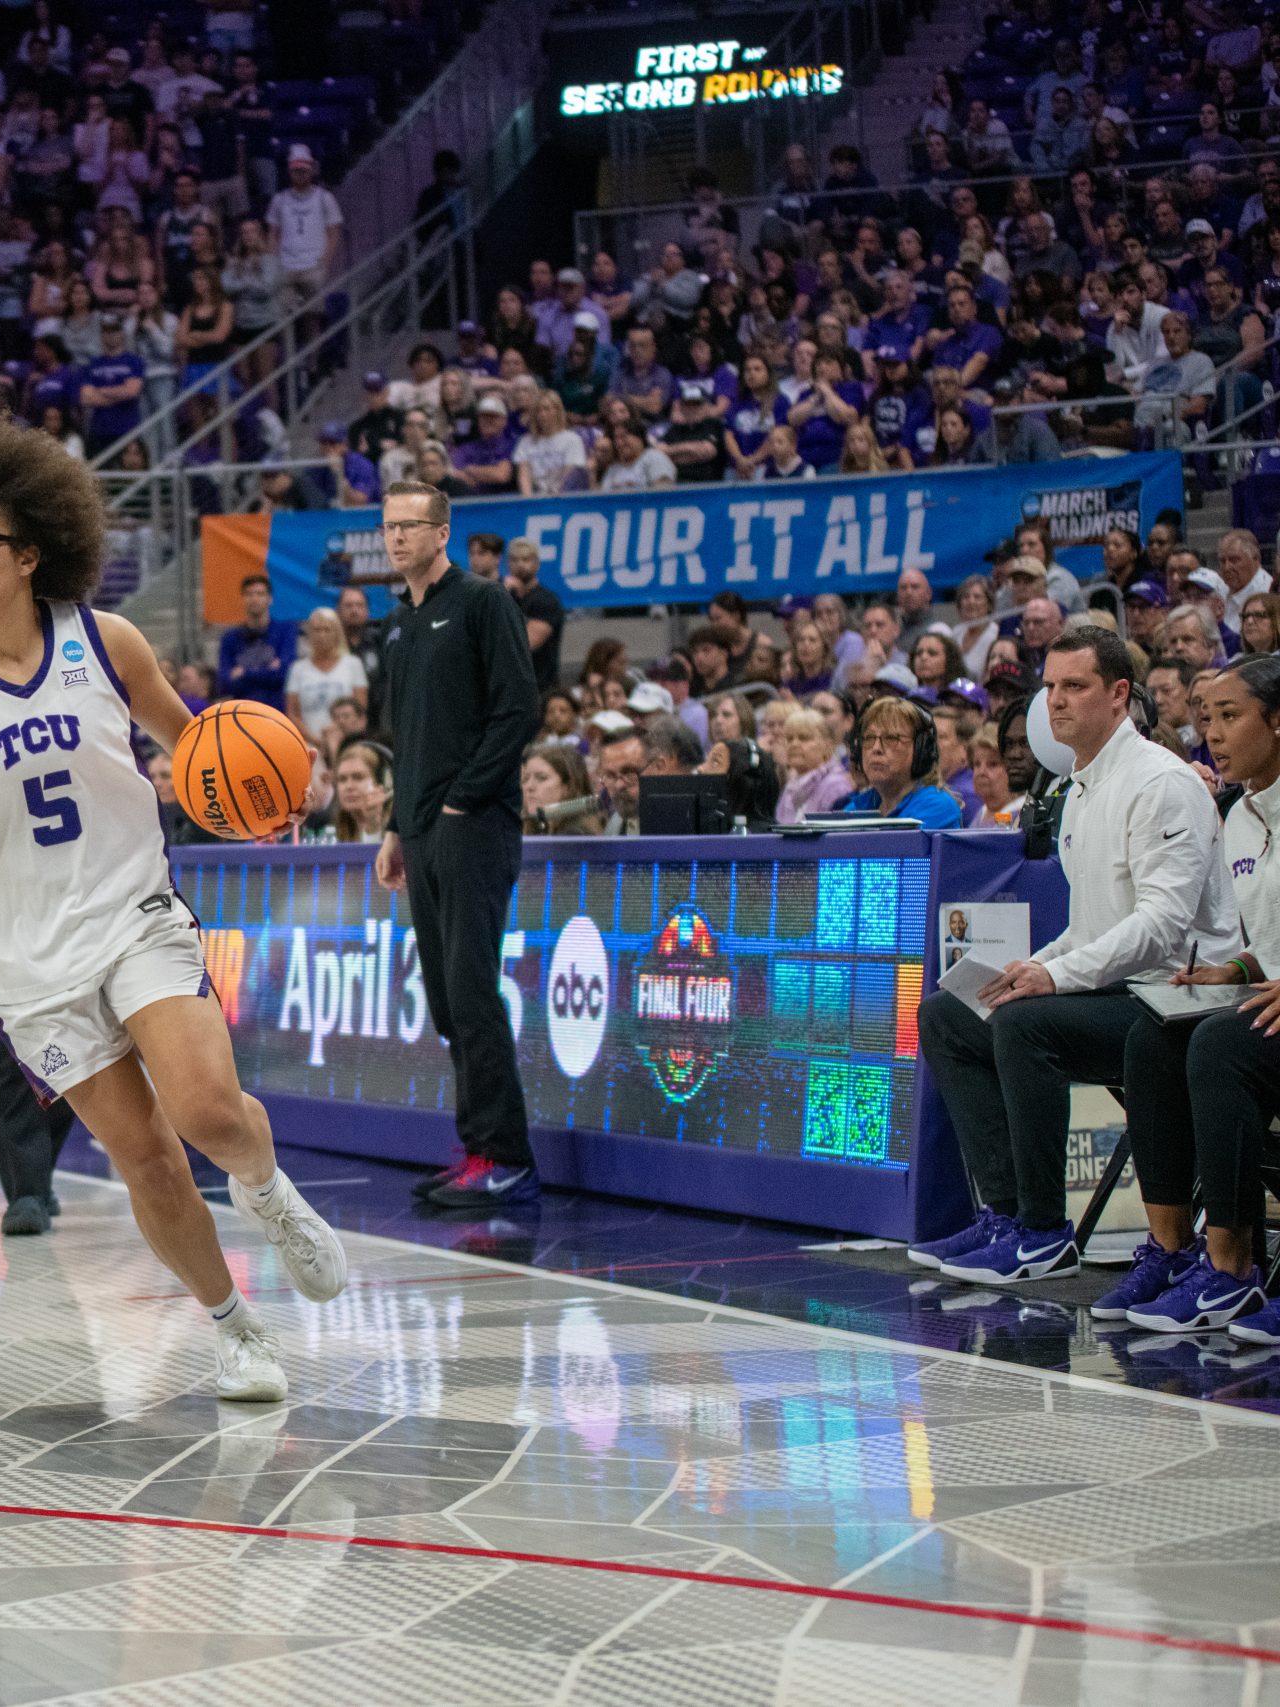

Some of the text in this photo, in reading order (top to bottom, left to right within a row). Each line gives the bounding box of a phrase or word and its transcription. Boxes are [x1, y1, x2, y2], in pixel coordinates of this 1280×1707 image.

[635, 41, 741, 77] FIRST
[1040, 489, 1107, 517] MARCH
[1050, 509, 1140, 540] MADNESS
[523, 490, 935, 591] FOUR IT ALL
[22, 769, 83, 847] 5
[201, 766, 240, 837] Wilson
[1232, 857, 1257, 880] TCU
[278, 918, 393, 1066] April
[553, 962, 605, 1020] abc
[637, 973, 731, 1024] FINAL FOUR
